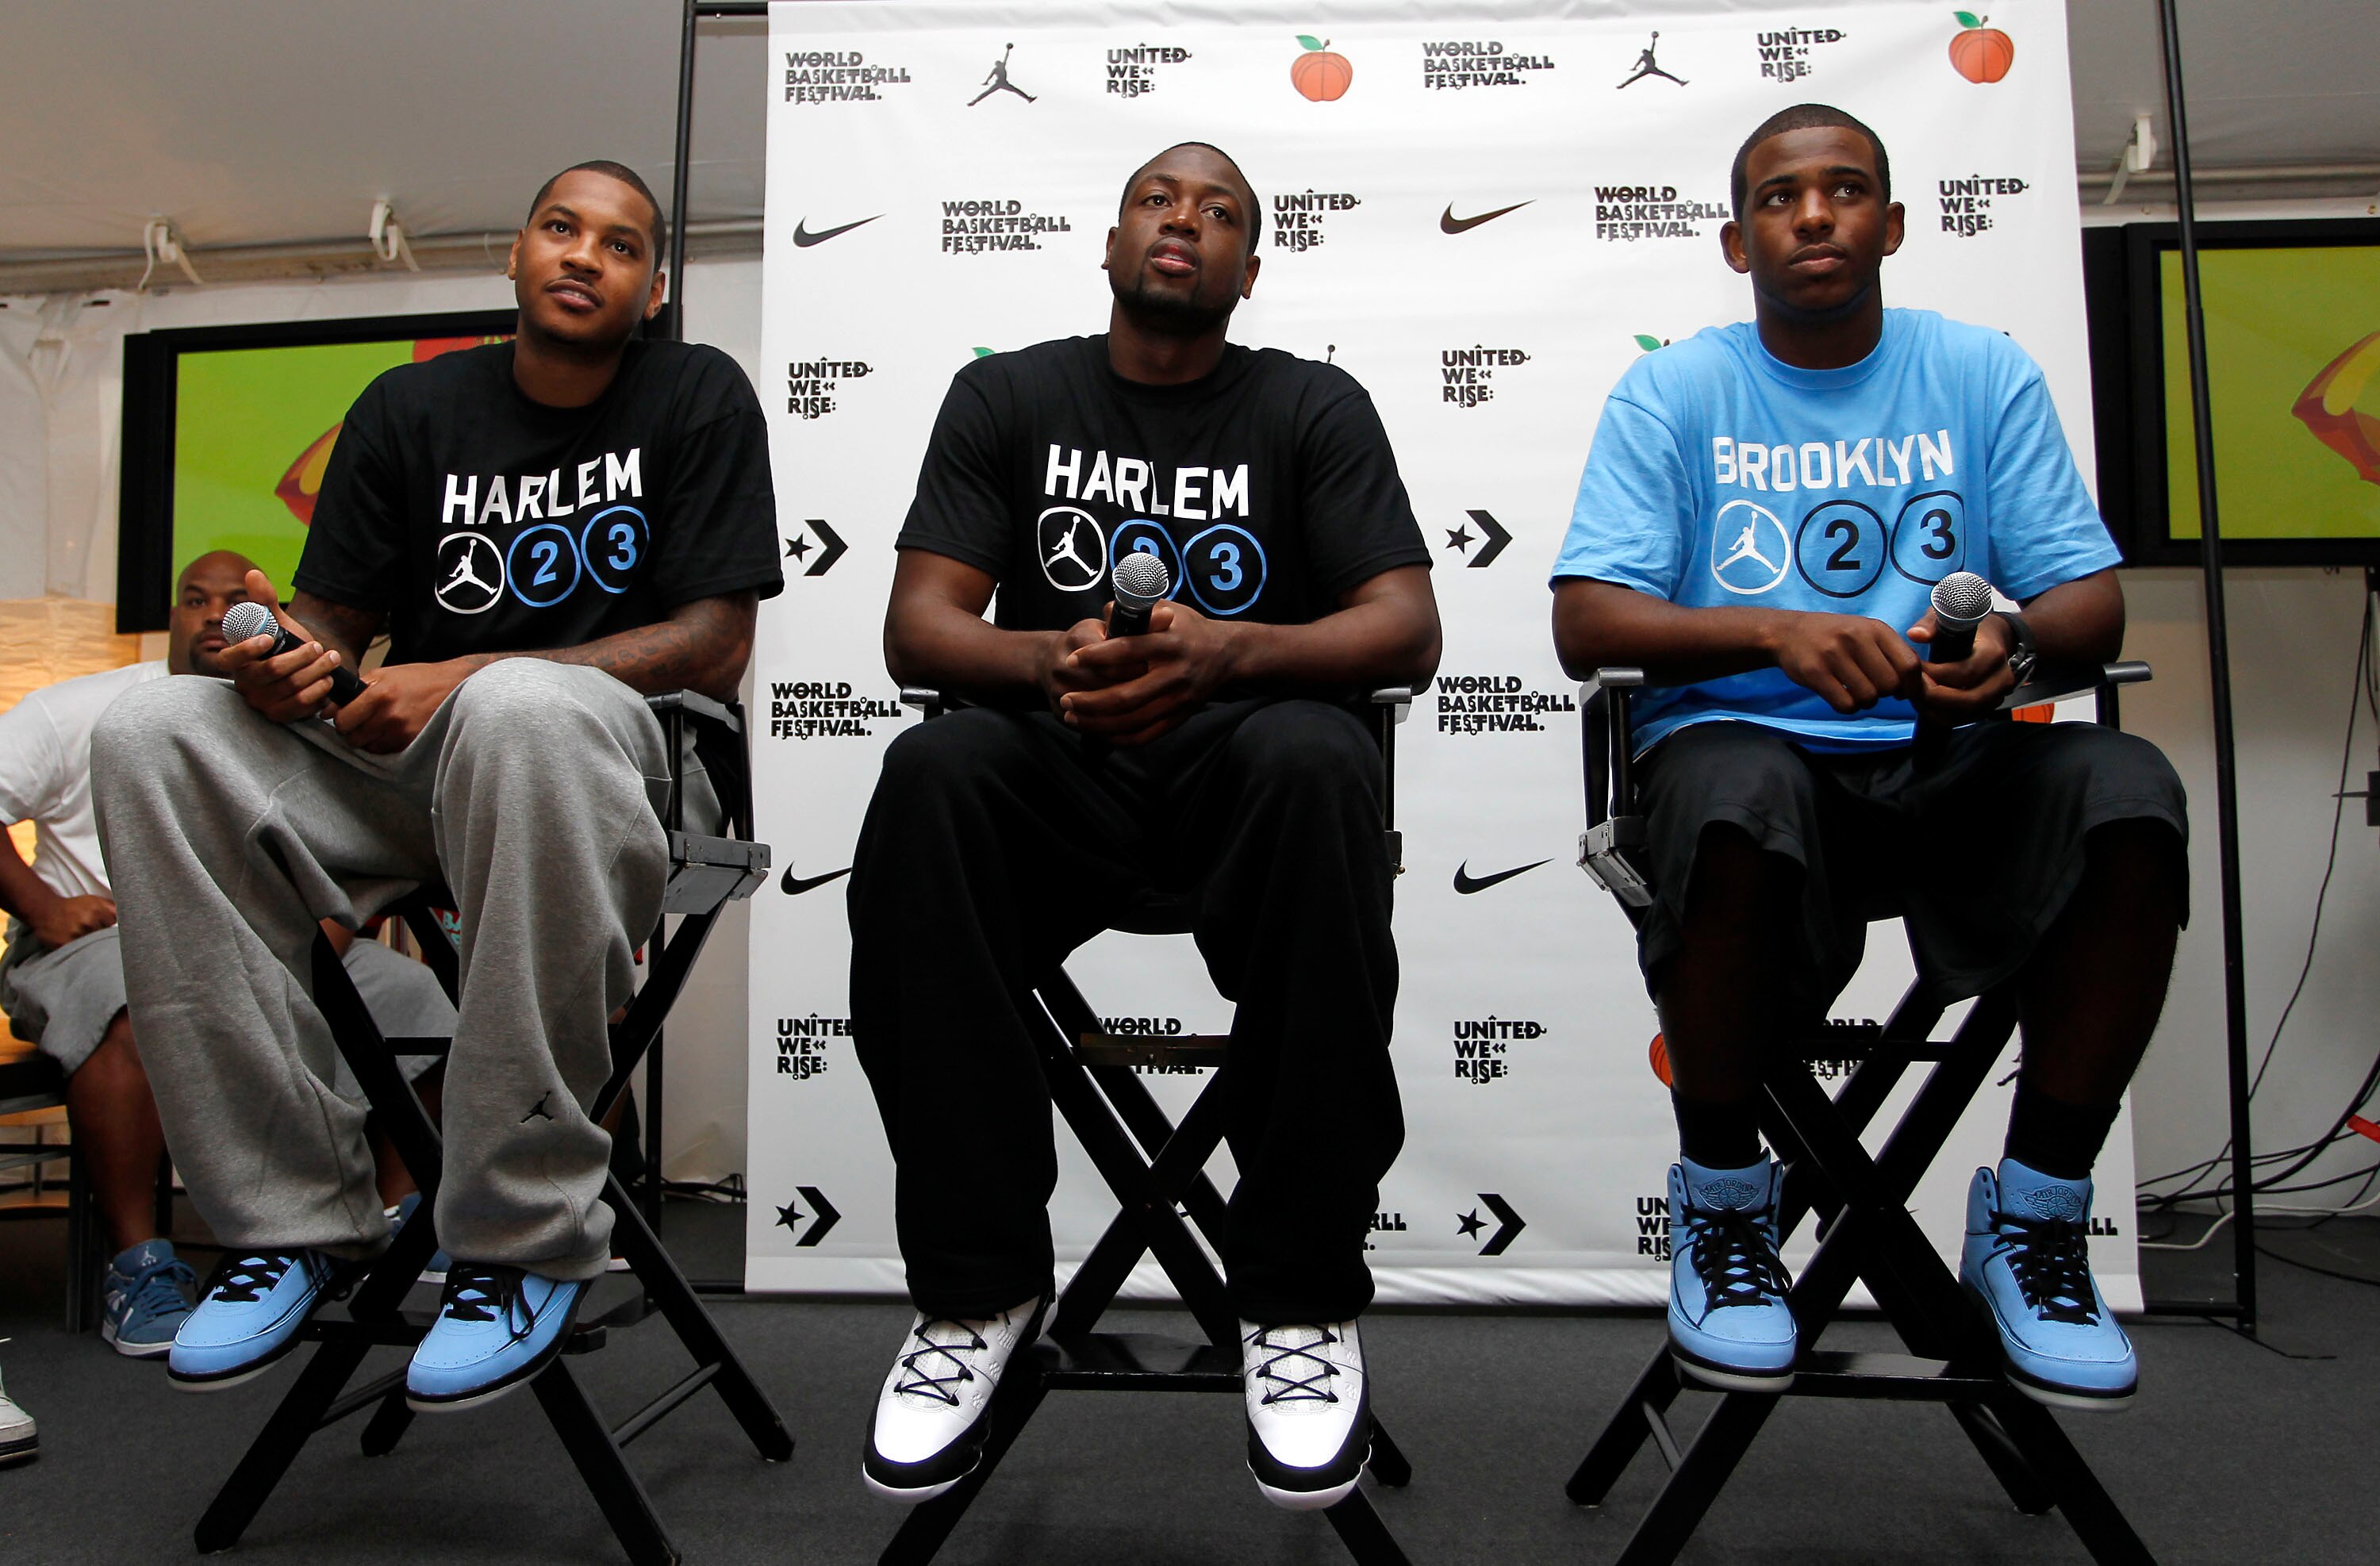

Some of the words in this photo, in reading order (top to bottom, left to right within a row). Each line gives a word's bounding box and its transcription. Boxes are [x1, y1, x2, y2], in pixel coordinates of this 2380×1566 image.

[785, 52, 863, 67] WORLD
[1422, 42, 1503, 57] WORLD
[1424, 54, 1555, 73] BASKETBALL
[785, 65, 911, 85] BASKETBALL
[1594, 186, 1677, 203] WORLD
[942, 200, 1022, 217] WORLD
[1595, 200, 1729, 221] BASKETBALL
[942, 213, 1071, 235] BASKETBALL
[1713, 429, 1953, 493] BROOKLYN
[442, 447, 643, 525] HARLEM
[1045, 444, 1250, 520] HARLEM
[1824, 519, 1861, 570] 2
[1921, 509, 1956, 561] 3
[532, 540, 560, 586] 2
[608, 523, 636, 570] 3
[1209, 543, 1242, 591] 3
[770, 681, 852, 700] WORLD
[1437, 676, 1522, 694] WORLD
[771, 696, 902, 720] BASKETBALL
[1438, 690, 1576, 716] BASKETBALL
